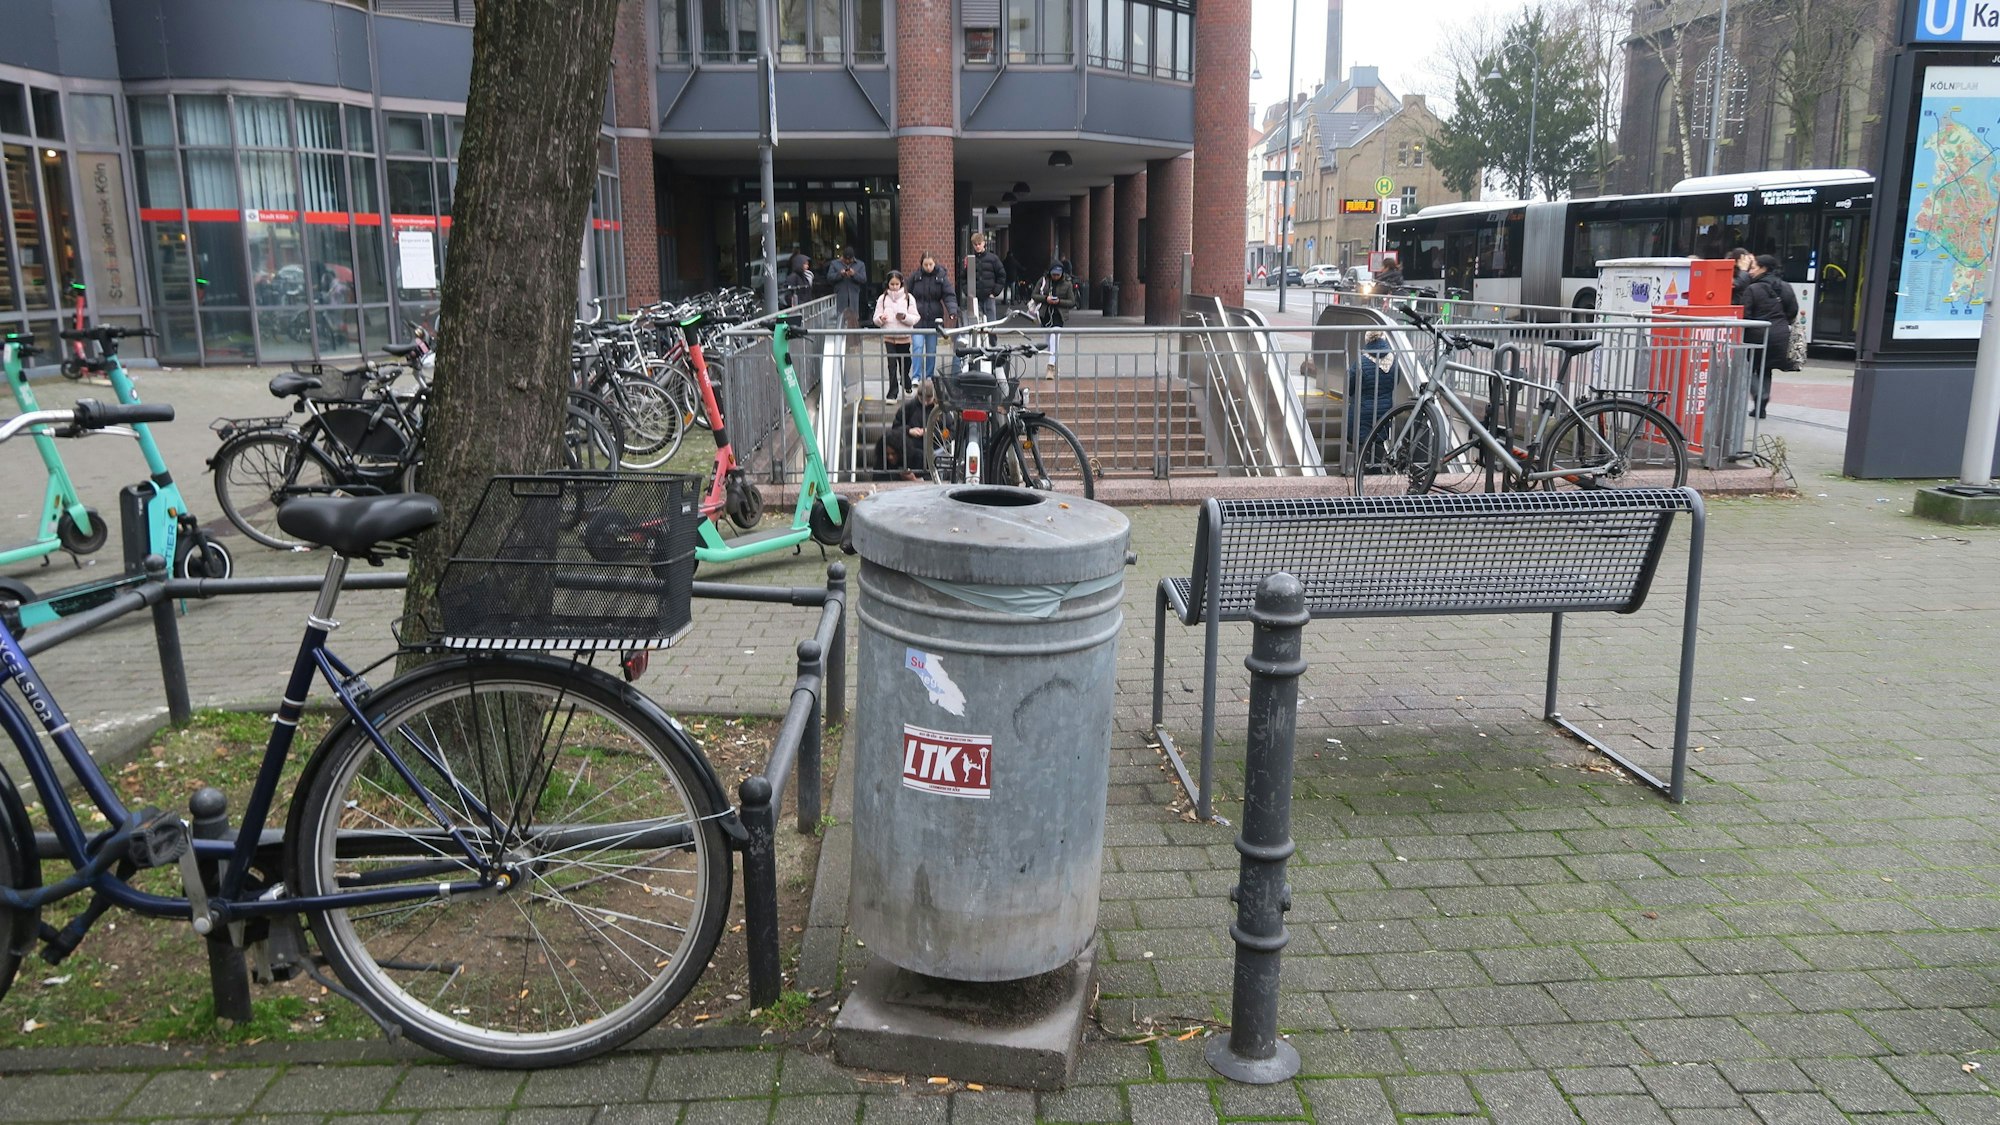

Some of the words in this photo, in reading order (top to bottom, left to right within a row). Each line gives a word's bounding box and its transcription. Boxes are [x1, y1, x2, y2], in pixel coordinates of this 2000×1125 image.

[1925, 0, 1957, 35] U
[94, 163, 108, 194] Köln
[1380, 180, 1388, 191] H
[1391, 204, 1398, 214] B
[1733, 193, 1748, 207] 159
[784, 366, 796, 388] Bolt
[165, 524, 175, 559] TIER
[911, 656, 925, 669] Su
[0, 634, 52, 722] XCELSIOR
[904, 739, 962, 782] LTK
